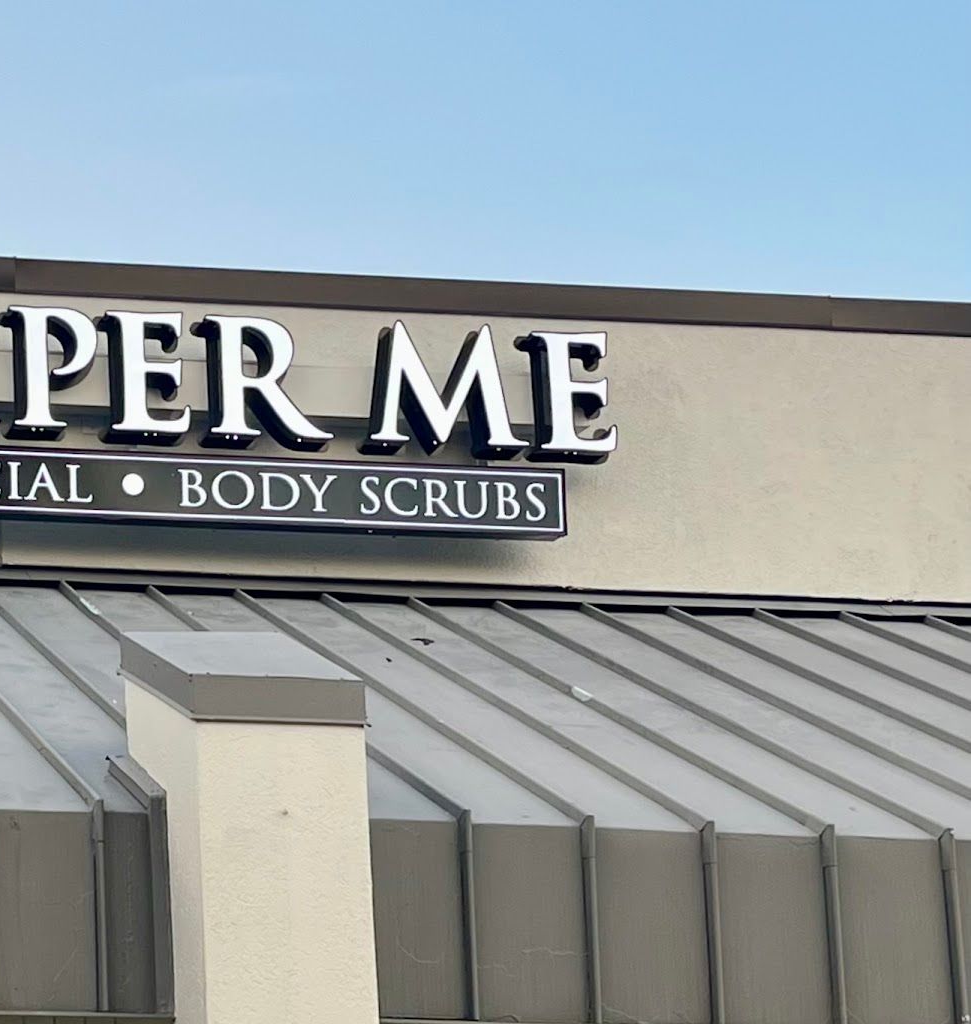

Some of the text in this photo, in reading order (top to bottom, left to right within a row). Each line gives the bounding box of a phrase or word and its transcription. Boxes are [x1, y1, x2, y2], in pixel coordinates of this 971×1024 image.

[368, 320, 617, 453] ME
[178, 467, 337, 513] BODY
[360, 476, 546, 522] SCRUBS
